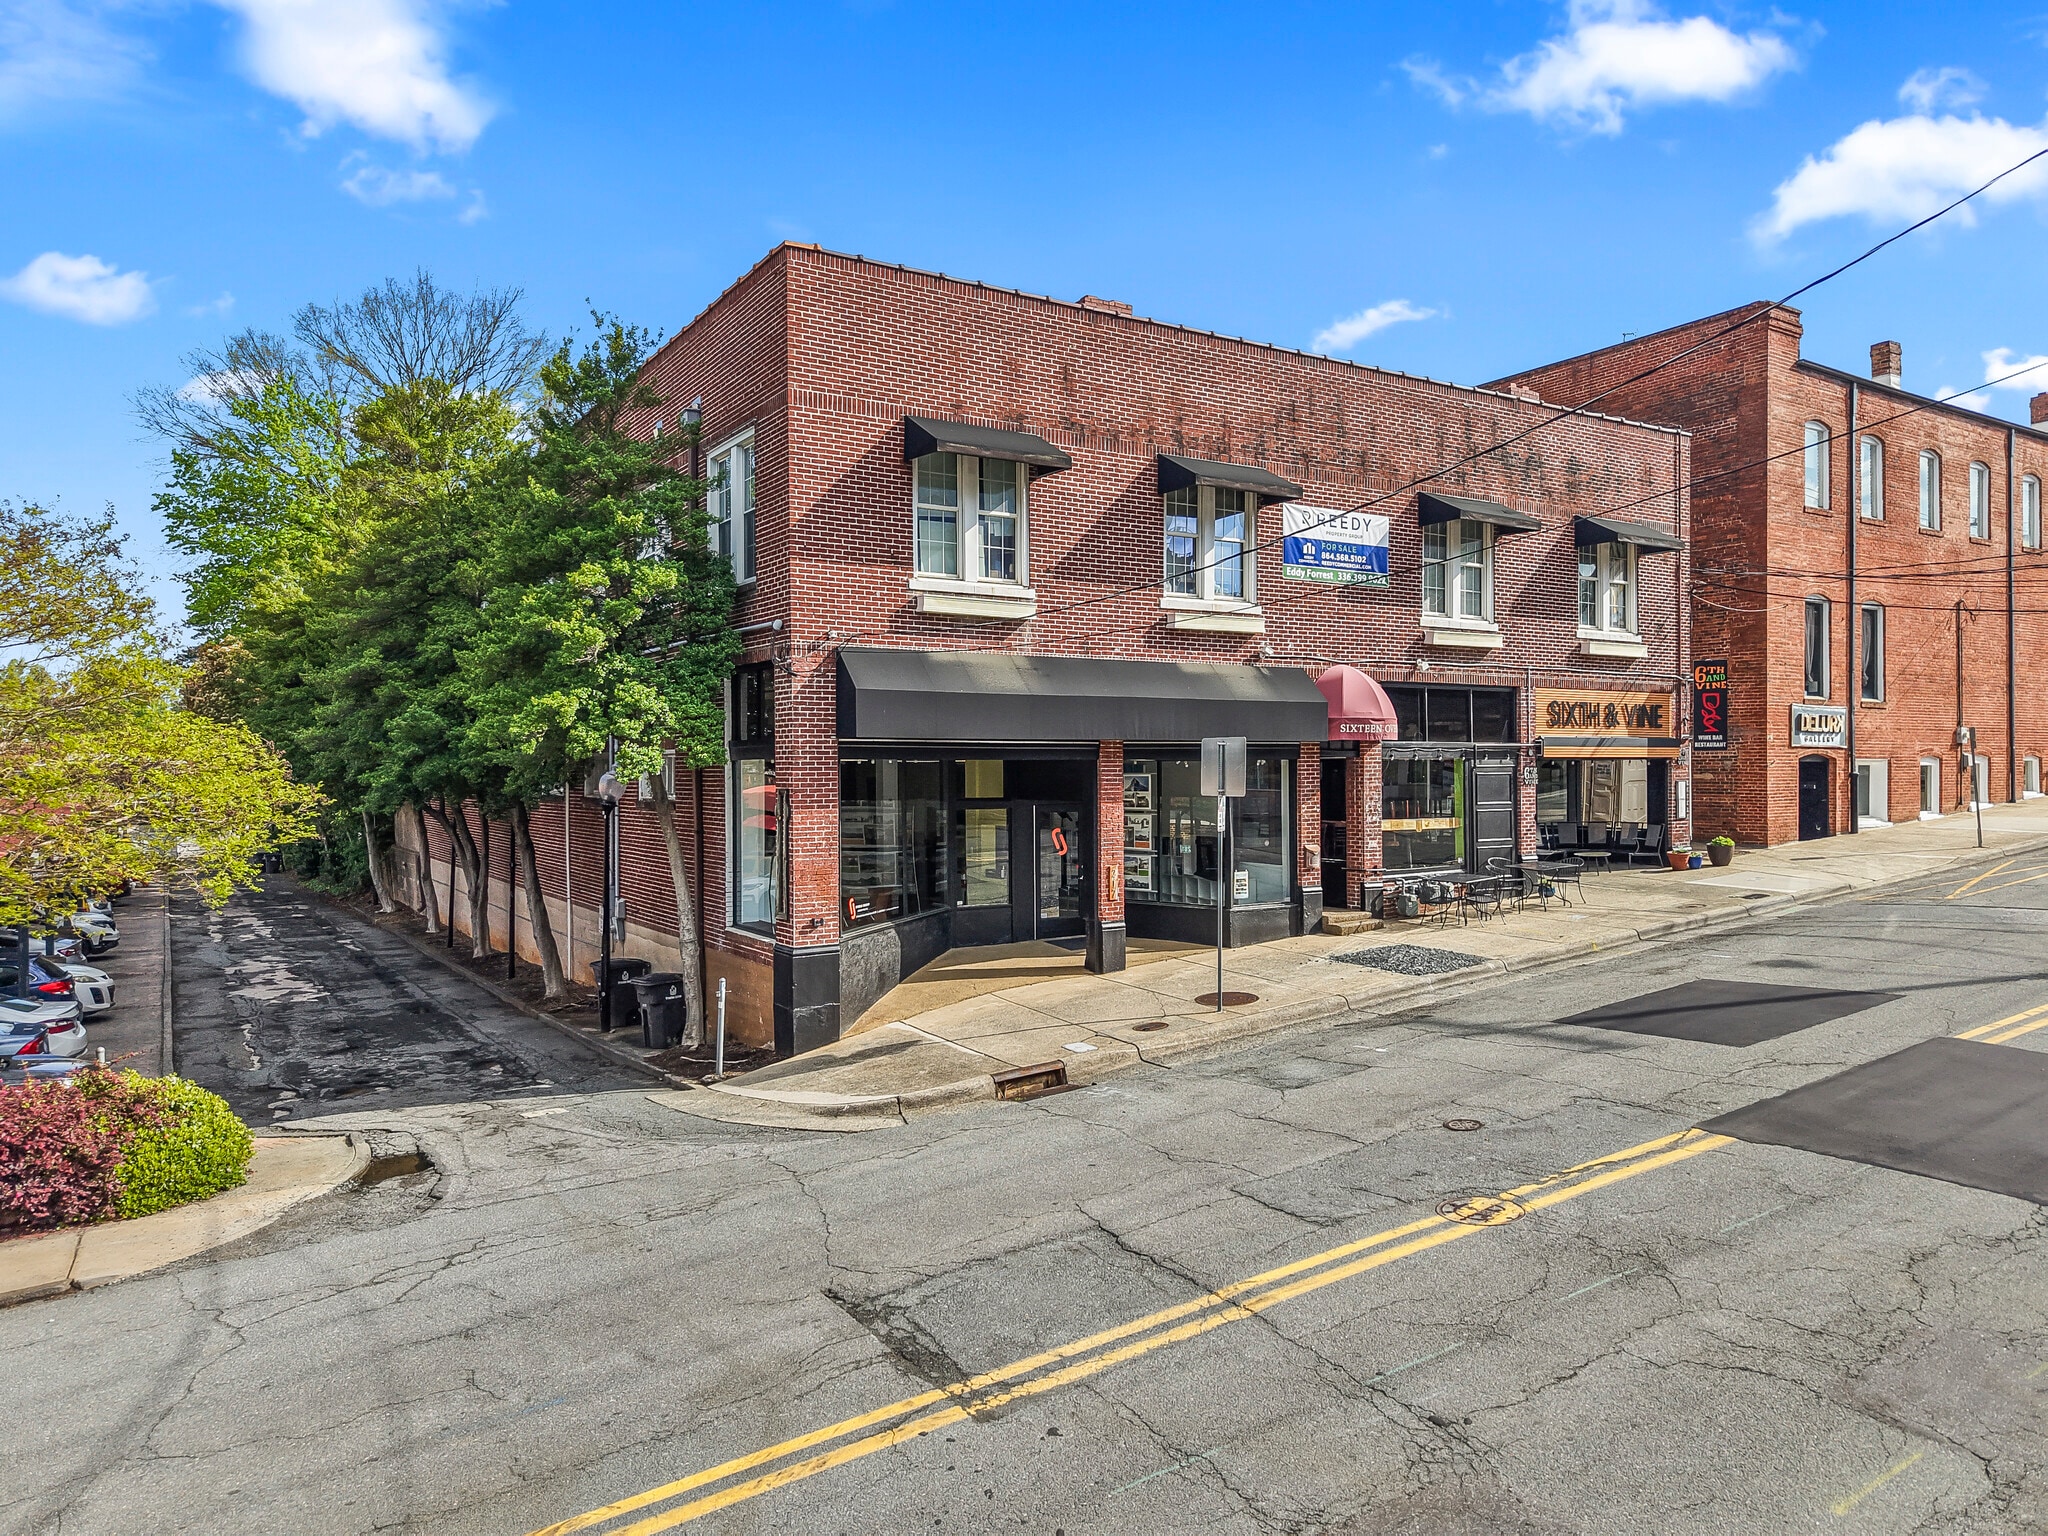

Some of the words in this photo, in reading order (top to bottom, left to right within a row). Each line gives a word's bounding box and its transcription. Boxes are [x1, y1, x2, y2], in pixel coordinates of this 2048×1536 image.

[1317, 512, 1372, 532] REEDY
[1321, 542, 1337, 551] FOR
[1338, 545, 1357, 554] SALE
[1321, 551, 1367, 563] 864.568.5102
[1286, 567, 1305, 579] Eddy
[1306, 569, 1334, 580] Forrest
[1694, 665, 1725, 683] 6TH
[1706, 673, 1726, 682] AND
[1695, 681, 1727, 690] VINE
[1549, 700, 1600, 728] SIXTH
[1606, 702, 1620, 727] &
[1624, 703, 1663, 728] VINE
[1340, 723, 1383, 733] SIXTEEN
